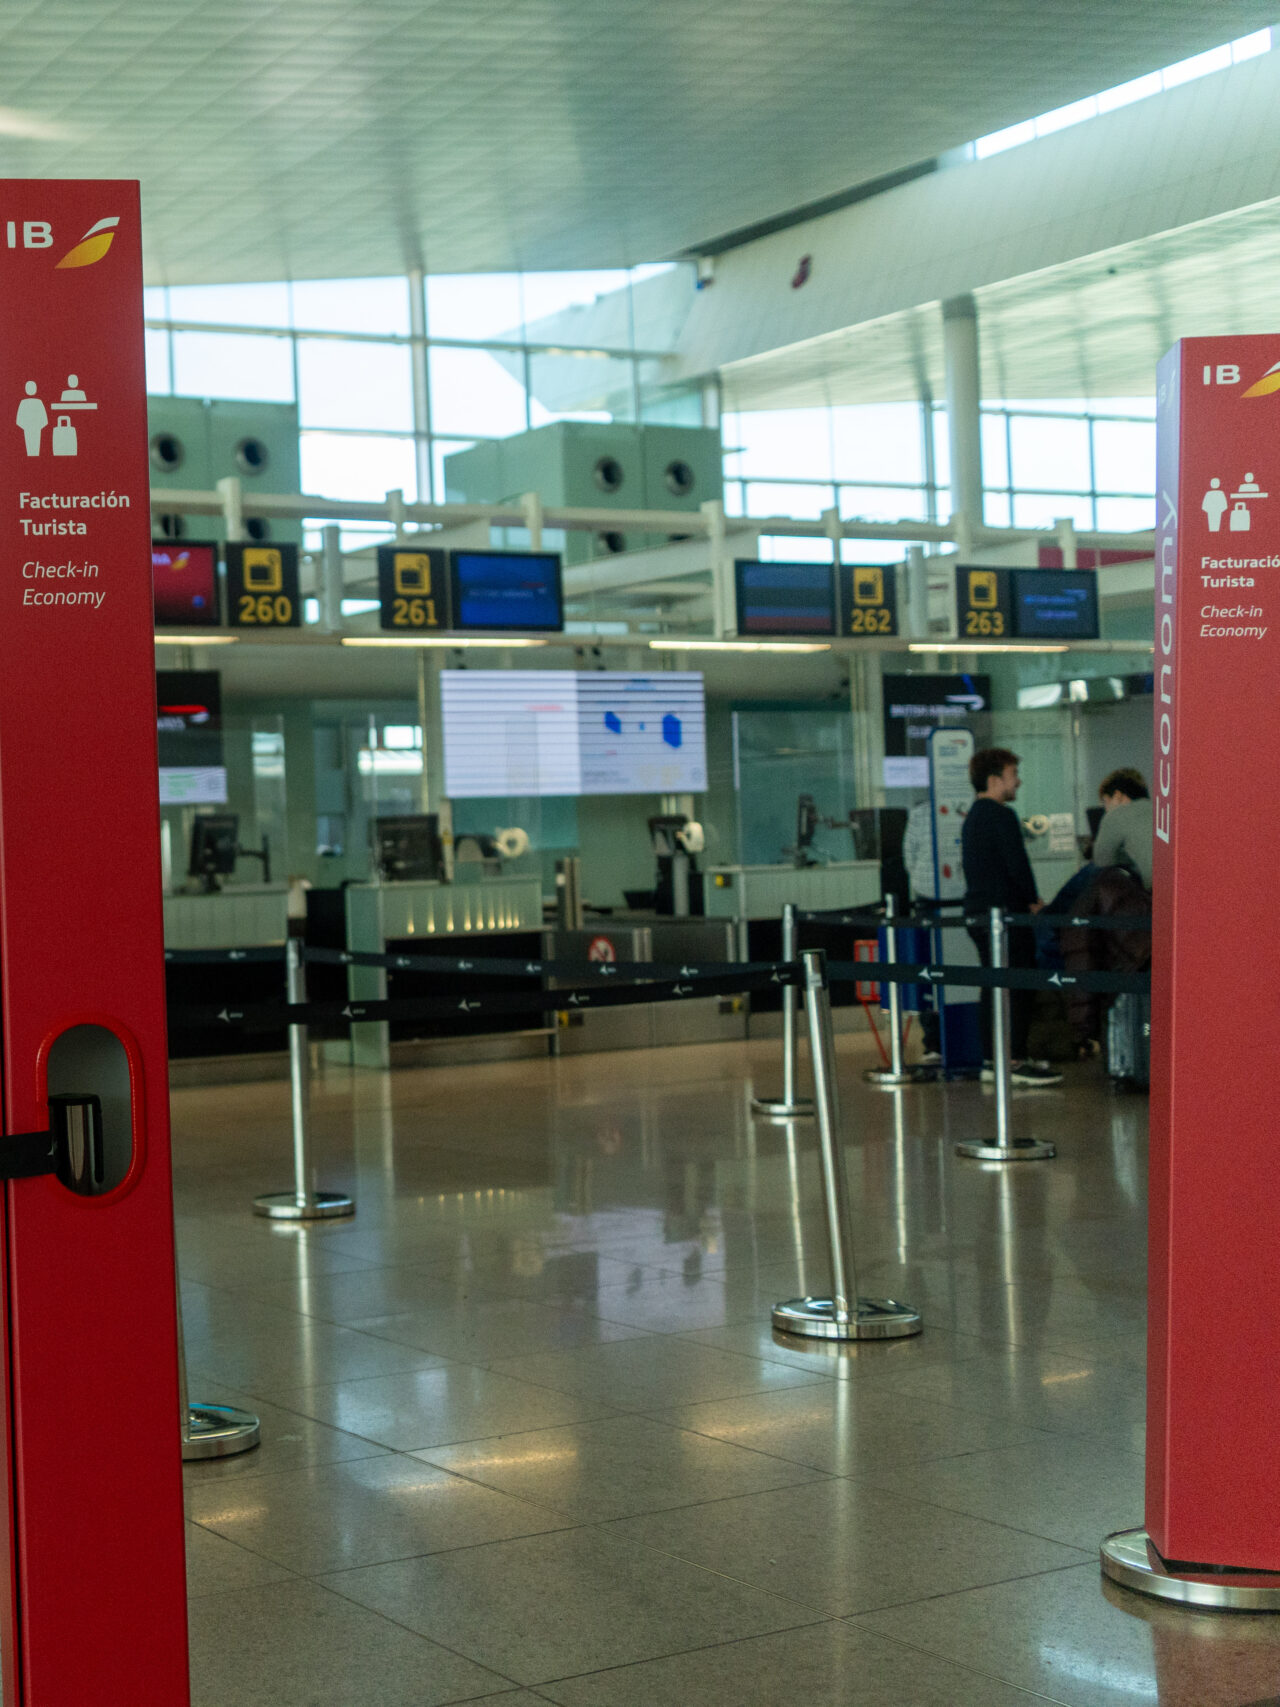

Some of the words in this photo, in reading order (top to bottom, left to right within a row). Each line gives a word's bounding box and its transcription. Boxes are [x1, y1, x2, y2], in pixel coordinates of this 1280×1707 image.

[6, 221, 54, 248] IB
[1202, 364, 1241, 386] IB
[19, 490, 131, 509] Facturación
[19, 518, 88, 536] Turista
[21, 560, 99, 579] Check-in
[1200, 554, 1280, 569] Facturació
[1200, 575, 1255, 588] Turista
[22, 588, 106, 609] Economy
[239, 595, 293, 624] 260
[392, 598, 438, 626] 261
[1200, 604, 1264, 618] Check-in
[851, 608, 892, 633] 262
[966, 610, 1005, 636] 263
[1200, 624, 1268, 640] Economy
[1155, 489, 1179, 845] Economy
